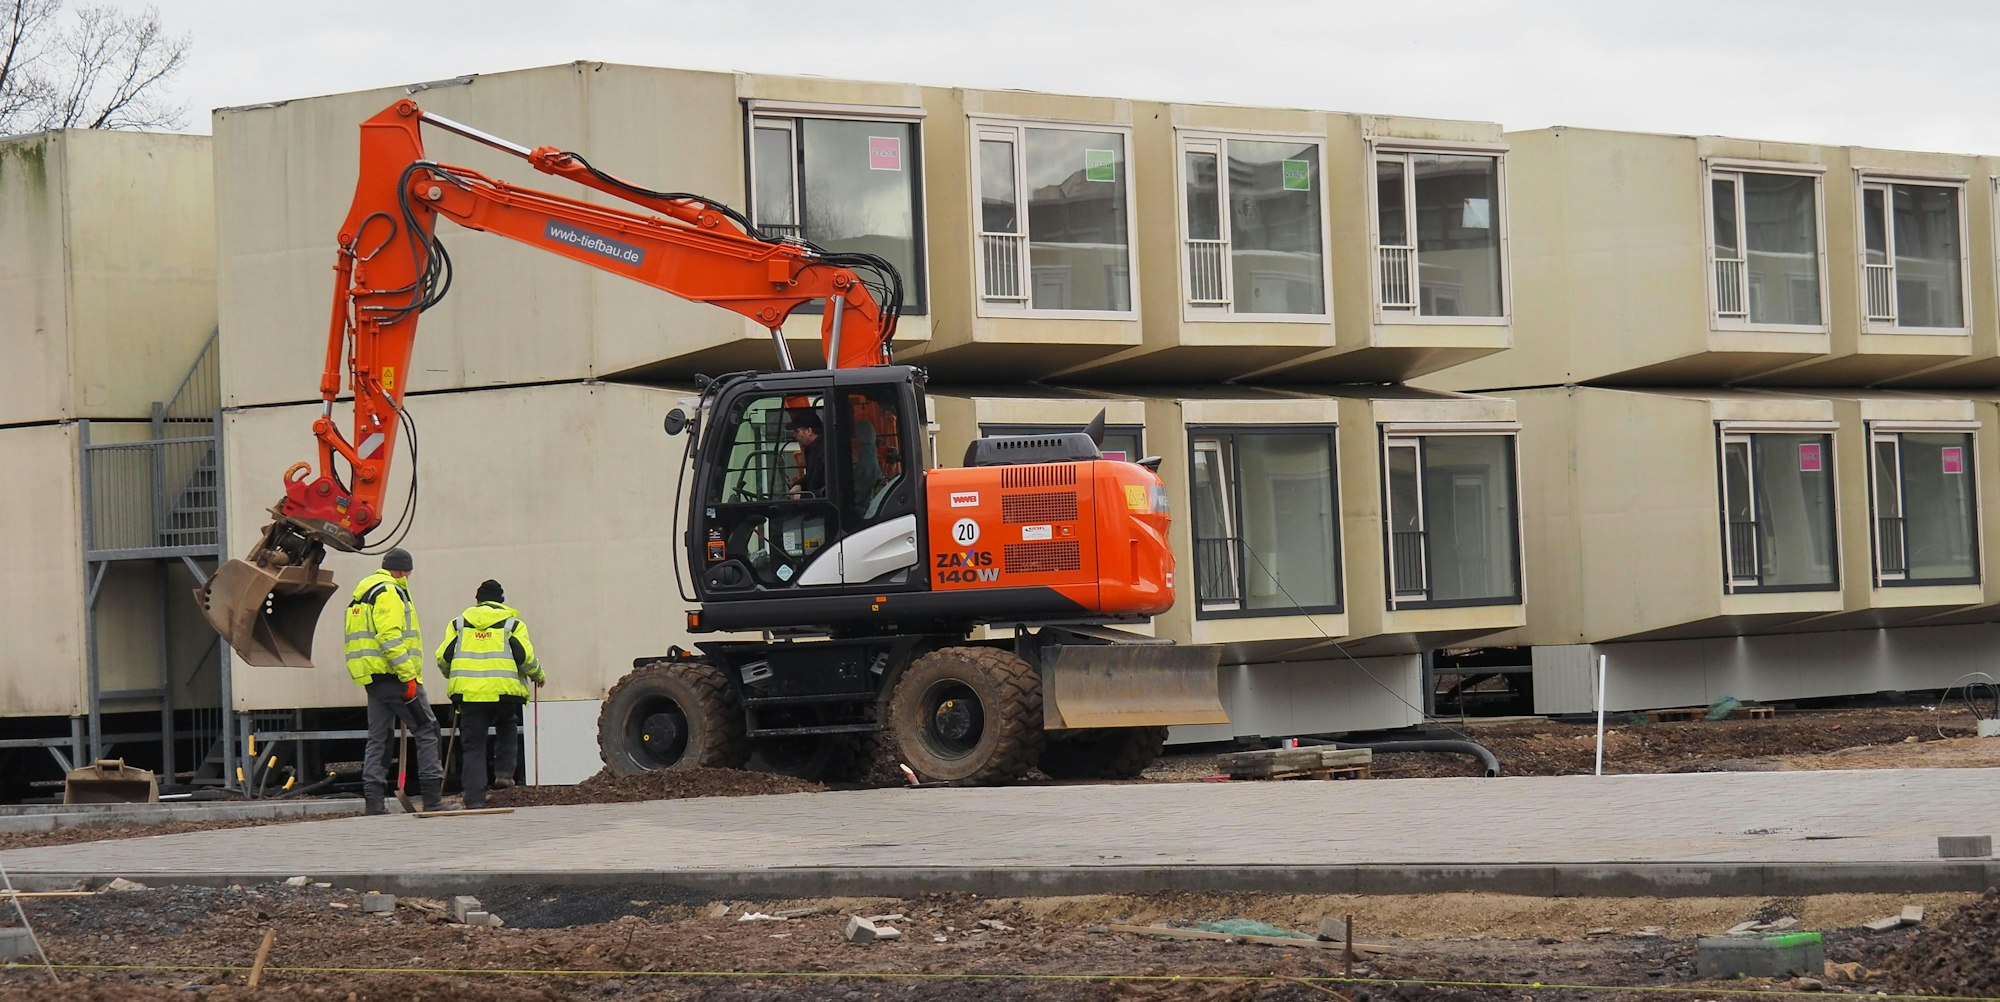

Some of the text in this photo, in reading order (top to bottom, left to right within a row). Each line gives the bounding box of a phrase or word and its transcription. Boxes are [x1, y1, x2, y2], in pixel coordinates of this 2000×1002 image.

[550, 226, 639, 262] wwb-tiefbau.de
[953, 495, 977, 503] WWB
[958, 523, 975, 541] 20
[936, 549, 993, 568] ZAXIS
[937, 568, 1000, 584] 140W
